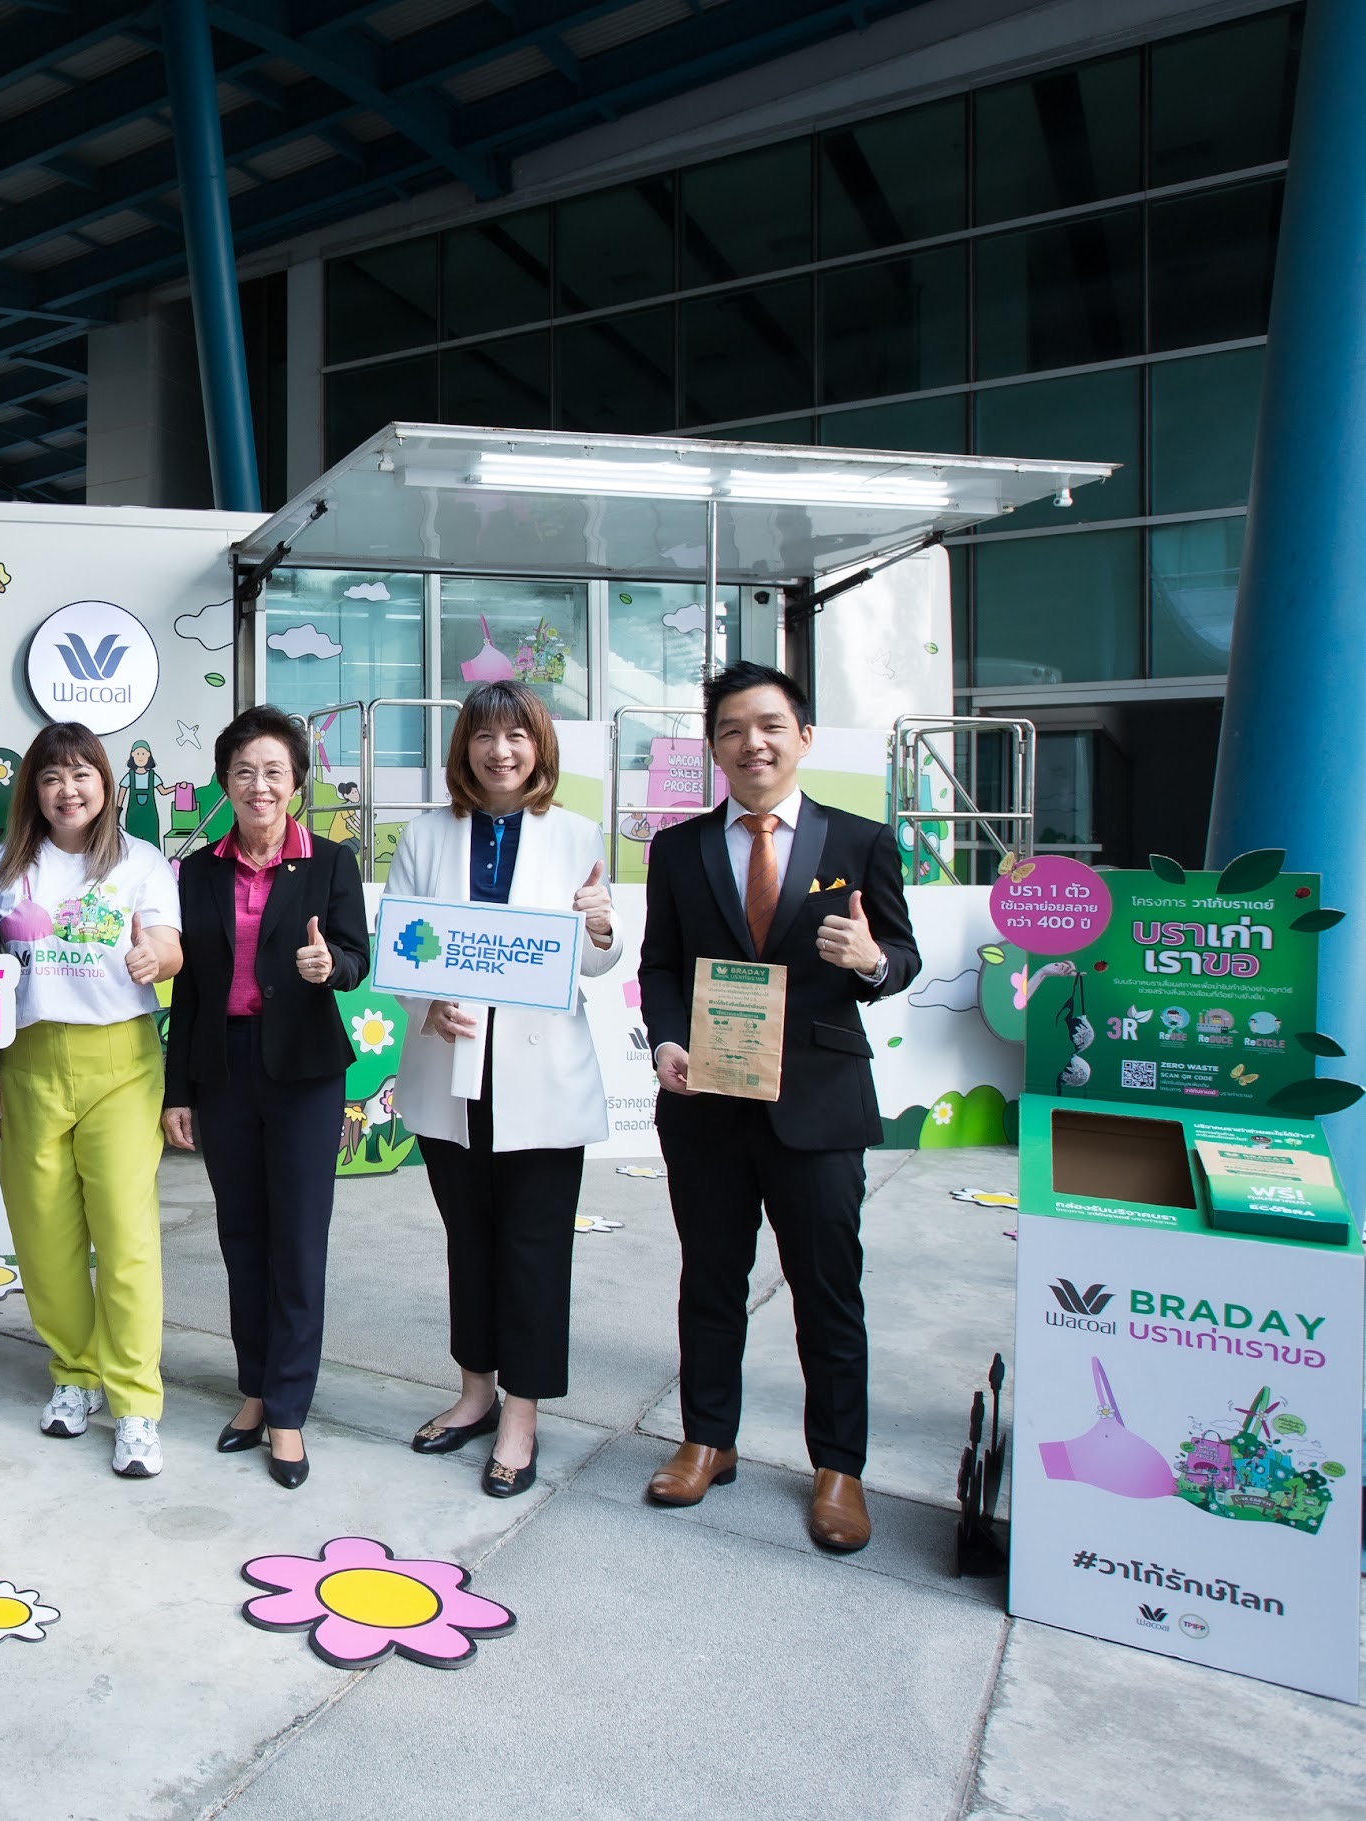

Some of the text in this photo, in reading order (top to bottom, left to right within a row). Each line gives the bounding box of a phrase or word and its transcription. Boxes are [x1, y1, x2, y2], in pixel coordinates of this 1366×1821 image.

[53, 682, 131, 703] Wacoal
[663, 780, 703, 793] PROCES
[1010, 883, 1090, 898] บรา 1 ตัว
[1000, 900, 1098, 912] ใช้เวลาย่อยสลาย
[1132, 896, 1275, 910] โครงการ วาโก้บราเดย์
[1007, 916, 1091, 929] กว่า 400 ปี
[1133, 916, 1273, 949] บราเก่า
[448, 930, 561, 953] THAILAND
[35, 950, 104, 965] BRADAY
[447, 943, 544, 965] SCIENCE
[35, 965, 105, 978] บราเก่าเราขอ
[445, 957, 505, 974] PARK
[730, 967, 766, 976] BRADAY
[1144, 950, 1260, 978] เราขอ
[1107, 1017, 1138, 1041] 3R
[1187, 1064, 1219, 1072] WASTE
[1250, 1186, 1305, 1201] ฟรี!
[1055, 1201, 1177, 1222] กล่องรับบริจาคบรา
[1046, 1310, 1116, 1335] Wacoal
[1129, 1289, 1325, 1340] BRADAY
[1129, 1321, 1326, 1369] บราเก่าเราขอ
[1073, 1550, 1285, 1616] #วาโก้รักษ์โลก
[1183, 1620, 1206, 1632] TPIPP
